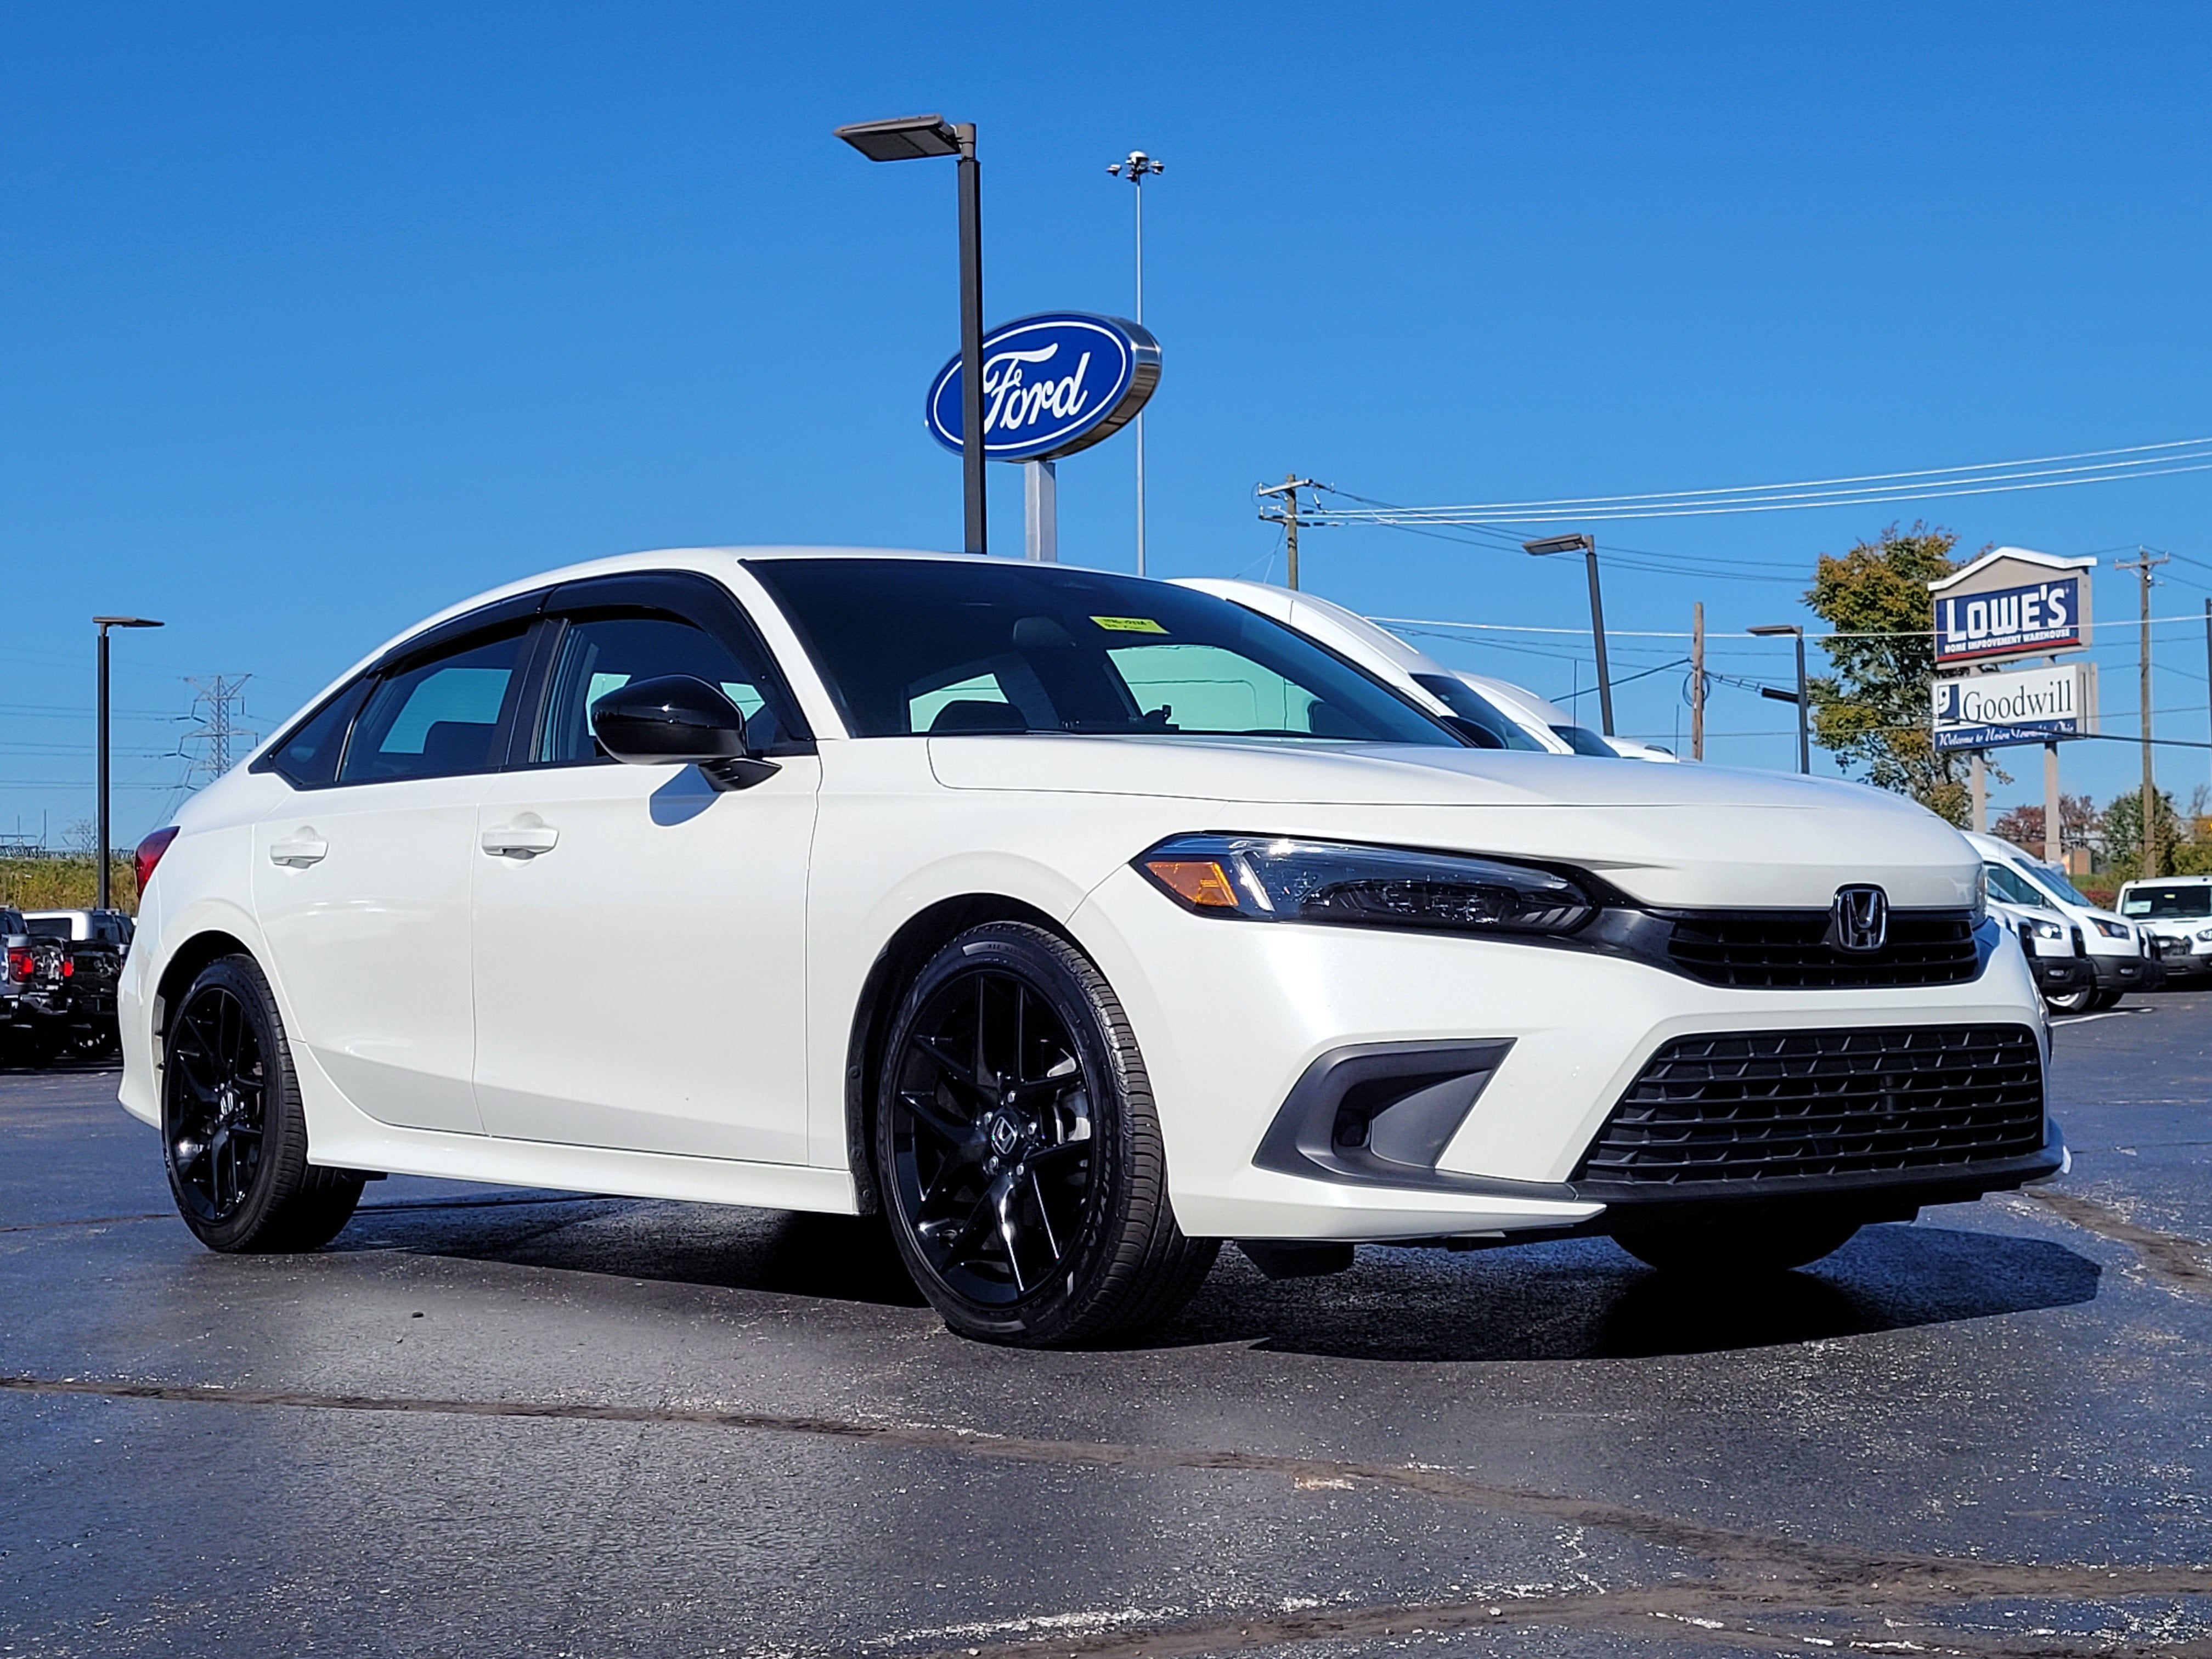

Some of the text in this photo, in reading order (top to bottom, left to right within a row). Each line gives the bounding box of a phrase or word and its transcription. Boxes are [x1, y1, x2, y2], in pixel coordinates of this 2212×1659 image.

[983, 342, 1091, 435] Ford
[1947, 585, 2067, 642] LOWE'S
[1968, 635, 2022, 650] IMPROVEMENT
[2023, 629, 2070, 642] WAREHOUSE
[1963, 679, 2073, 722] Goodwill
